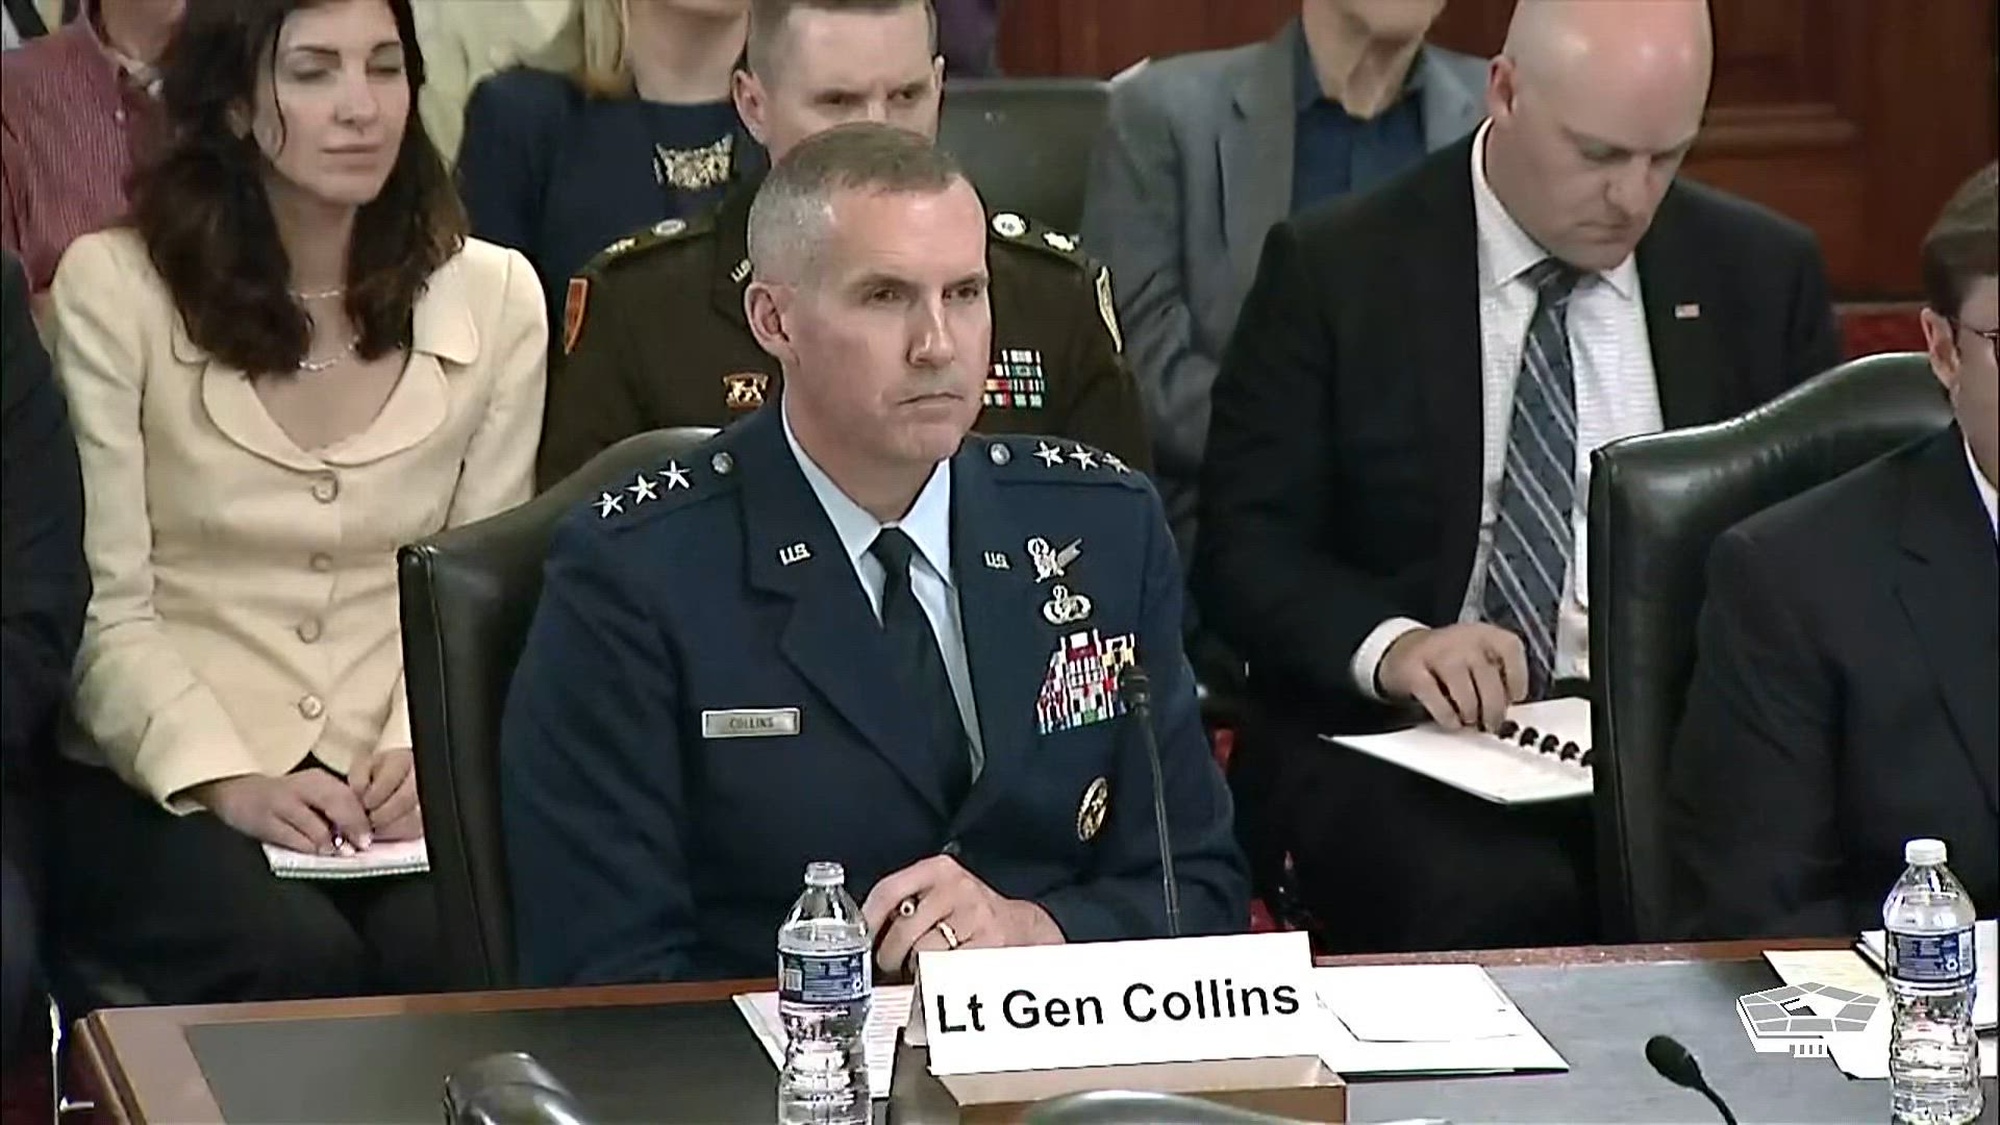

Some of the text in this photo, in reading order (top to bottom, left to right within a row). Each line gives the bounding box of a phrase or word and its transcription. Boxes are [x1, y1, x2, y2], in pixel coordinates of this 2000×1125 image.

[729, 716, 774, 729] COLLINS
[936, 993, 986, 1034] Lt
[1002, 989, 1104, 1030] Gen
[1122, 978, 1300, 1023] Collins
